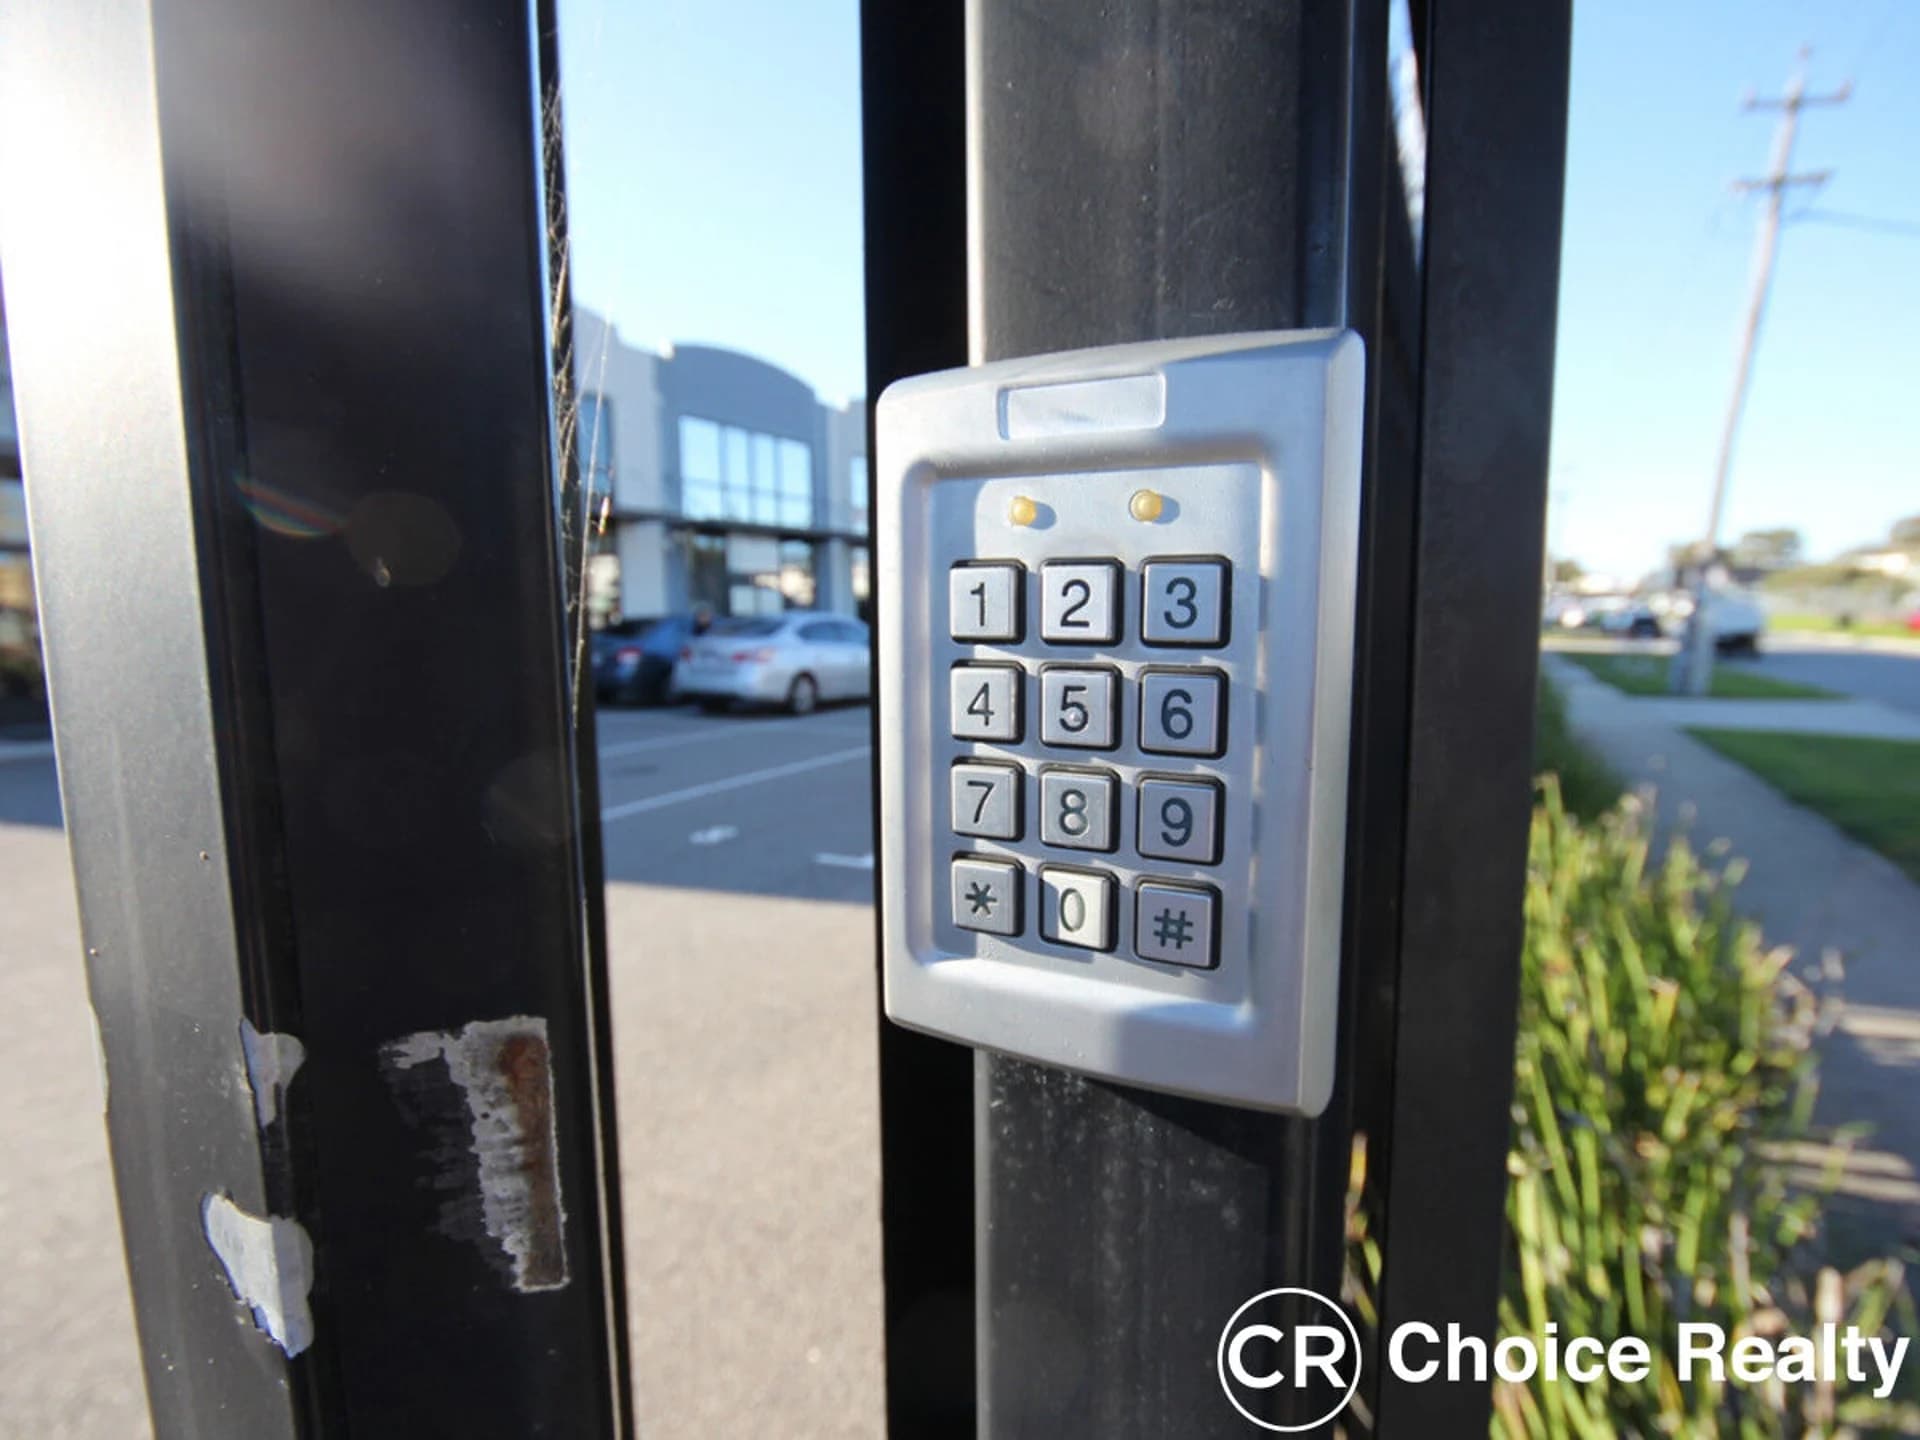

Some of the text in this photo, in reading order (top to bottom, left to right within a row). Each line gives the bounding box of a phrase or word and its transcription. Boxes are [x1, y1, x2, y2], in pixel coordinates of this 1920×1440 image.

[970, 576, 1198, 629] 1 2 3
[966, 682, 1193, 739] 4 5 6
[966, 780, 1193, 847] 7 8 9
[1060, 887, 1086, 933] 0
[1153, 908, 1194, 950] #
